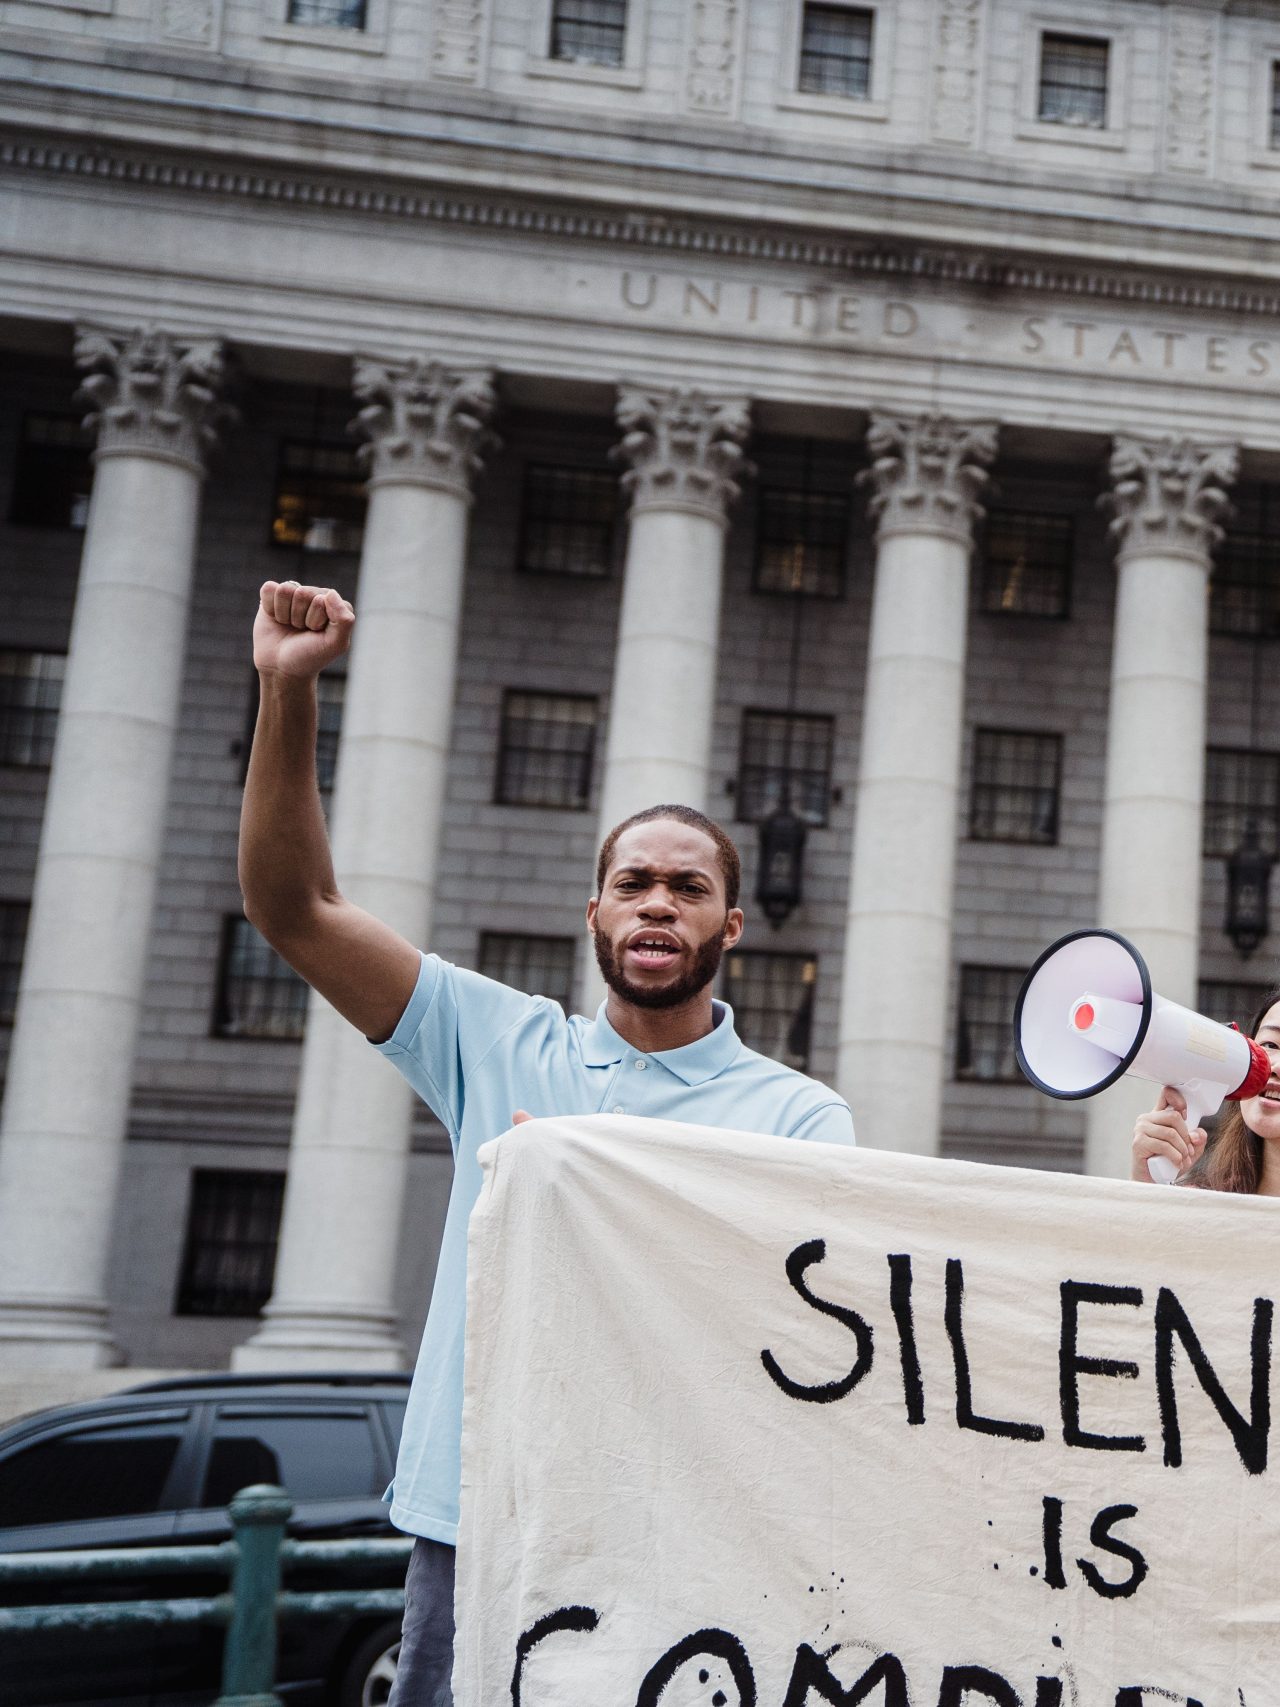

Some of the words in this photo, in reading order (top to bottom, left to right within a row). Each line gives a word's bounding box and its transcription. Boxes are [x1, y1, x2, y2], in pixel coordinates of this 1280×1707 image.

[620, 271, 919, 339] UNITED
[1020, 317, 1273, 378] STATES
[1041, 1495, 1149, 1599] IS
